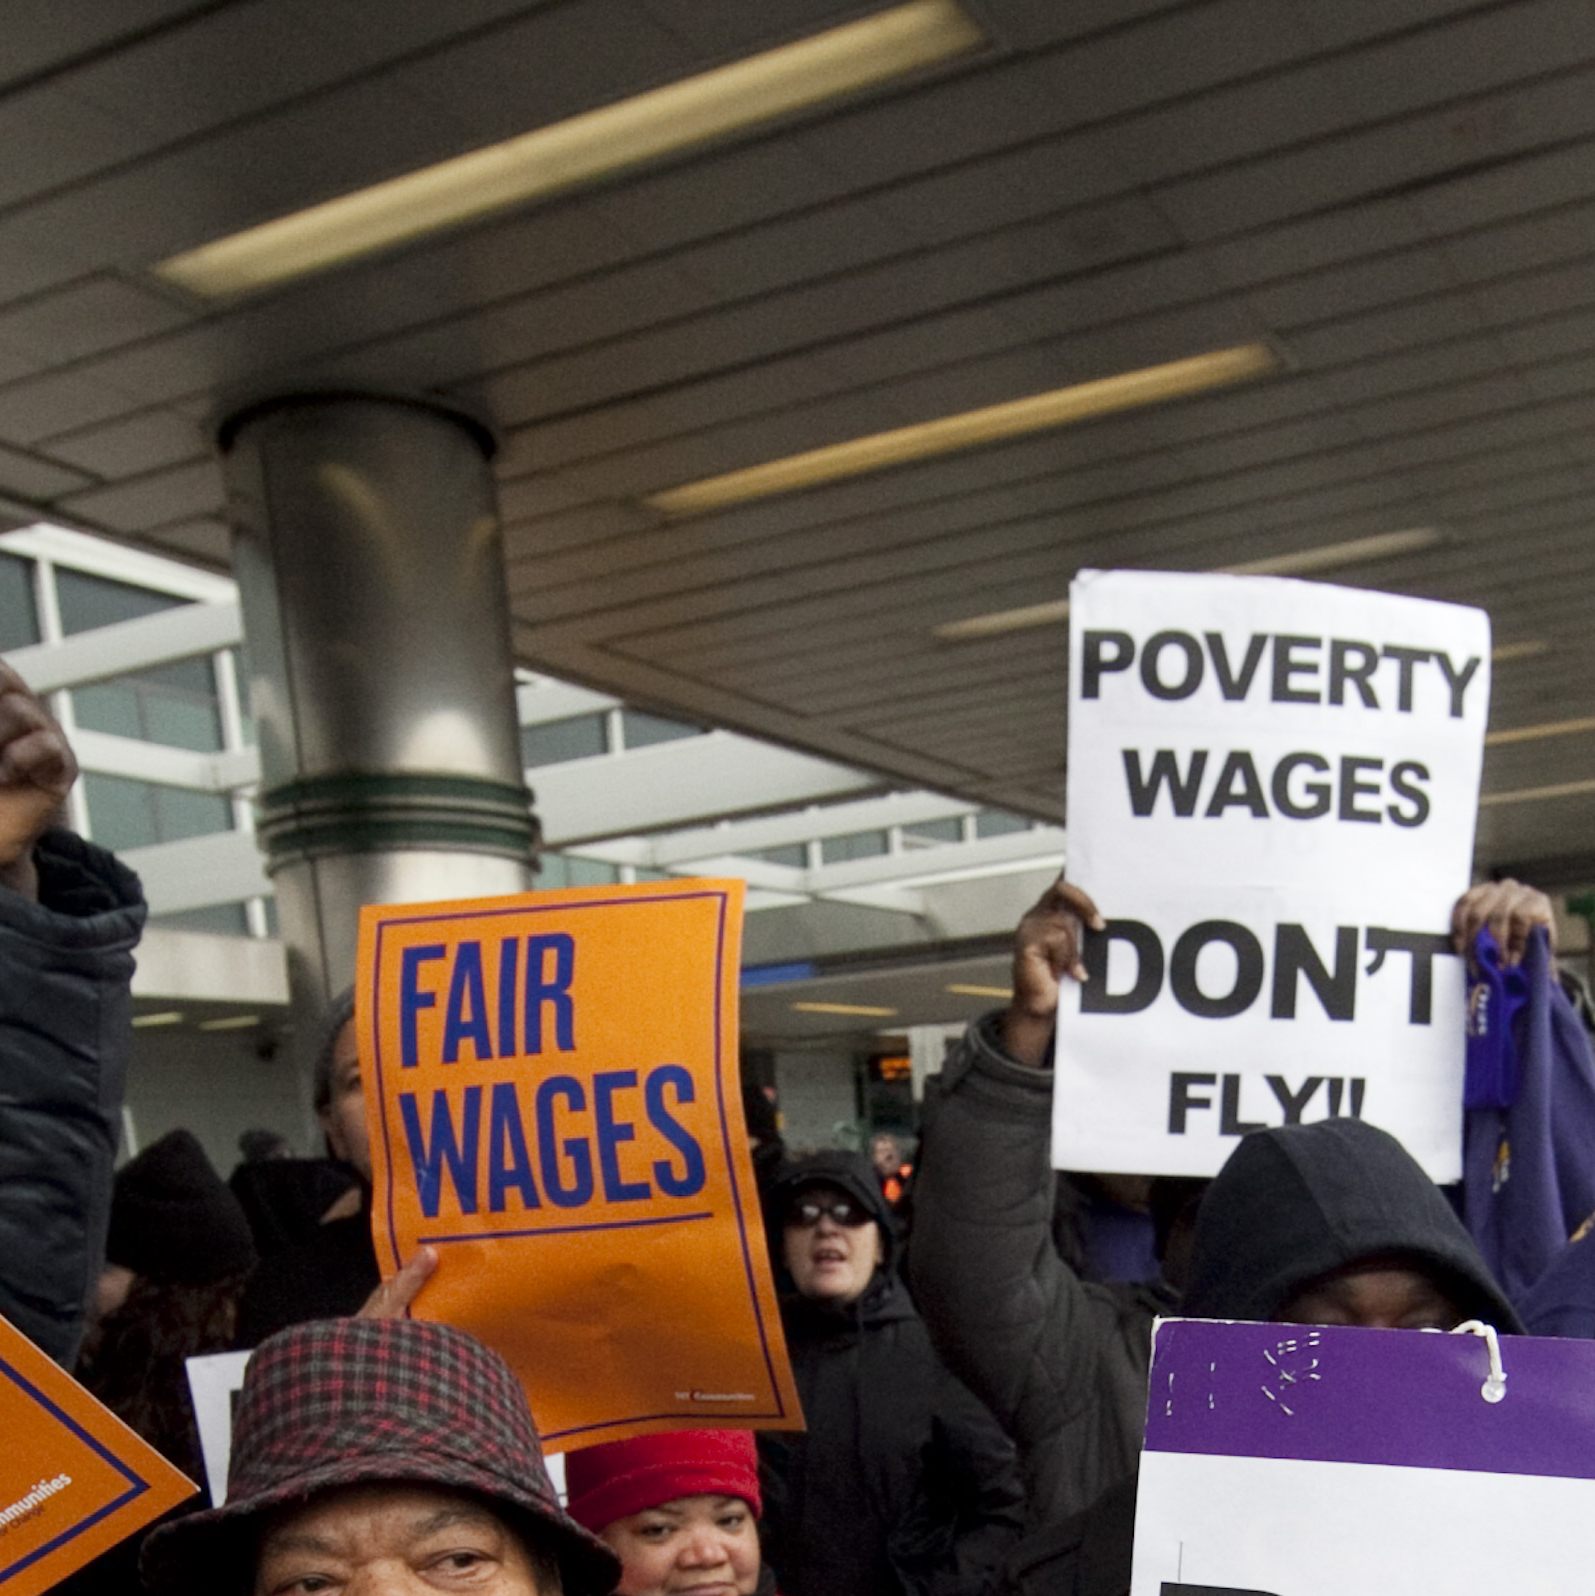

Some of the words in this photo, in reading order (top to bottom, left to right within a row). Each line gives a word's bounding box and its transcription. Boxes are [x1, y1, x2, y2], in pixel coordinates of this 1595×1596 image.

[1080, 630, 1481, 718] POVERTY
[1121, 748, 1432, 828] WAGES
[400, 933, 575, 1069] FAIR
[1079, 918, 1461, 1027] DON'T
[400, 1065, 707, 1218] WAGES
[1167, 1072, 1367, 1136] FLY!!
